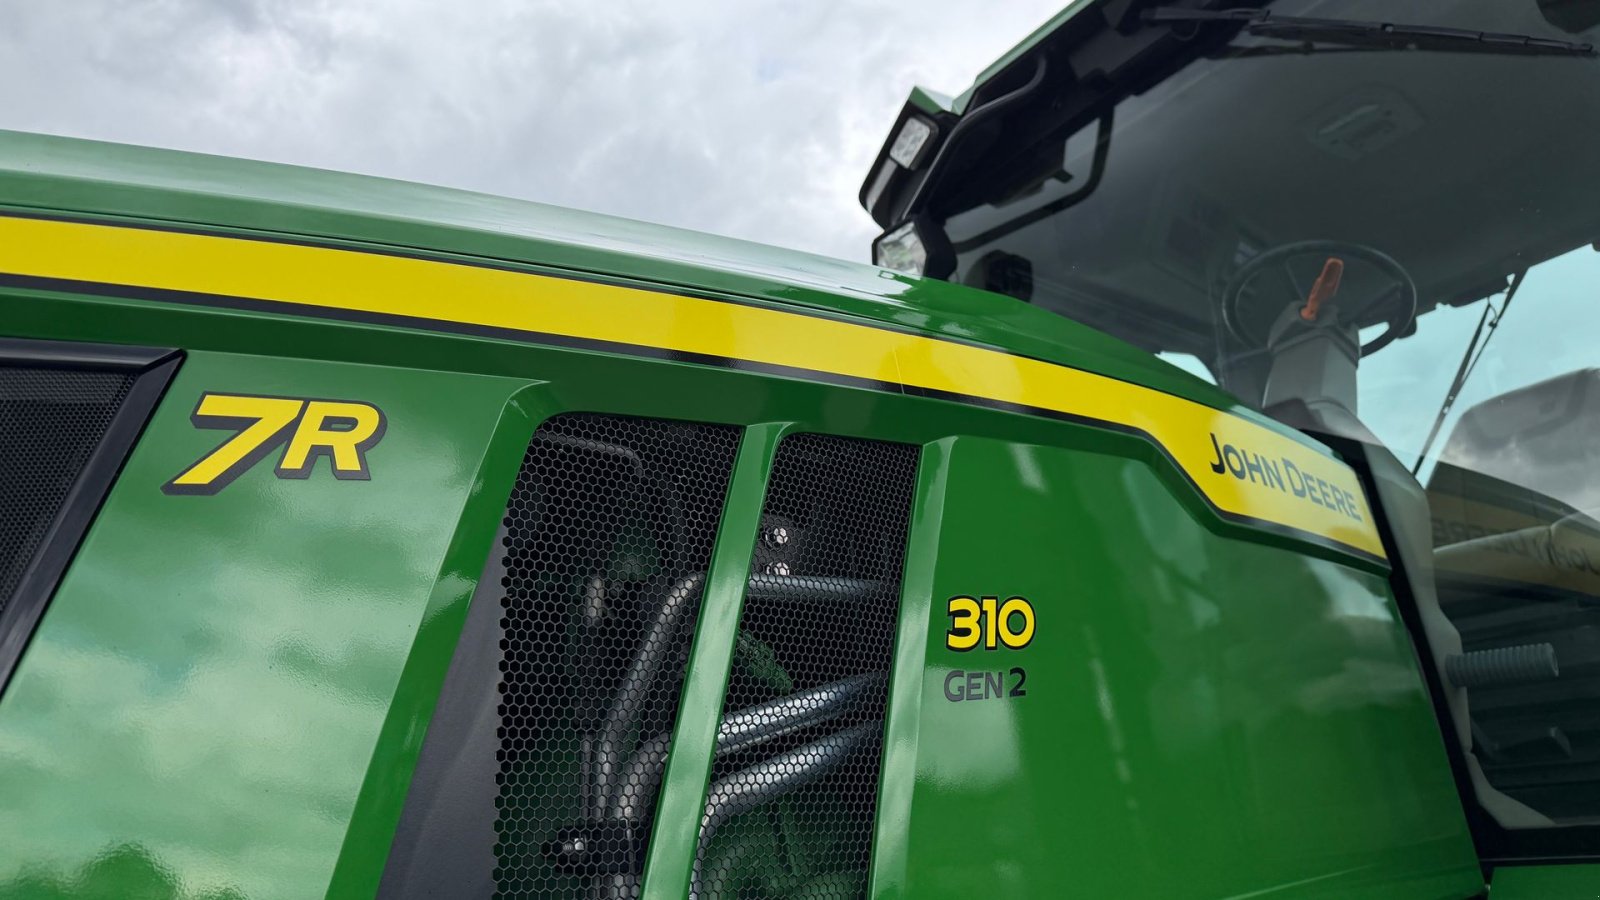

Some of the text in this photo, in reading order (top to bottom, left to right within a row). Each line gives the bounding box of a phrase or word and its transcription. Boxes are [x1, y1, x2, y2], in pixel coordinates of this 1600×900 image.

[160, 391, 388, 496] 7R
[1210, 432, 1362, 522] JOHN DEERE
[945, 594, 1037, 653] 310
[943, 667, 1027, 702] GEN 2
